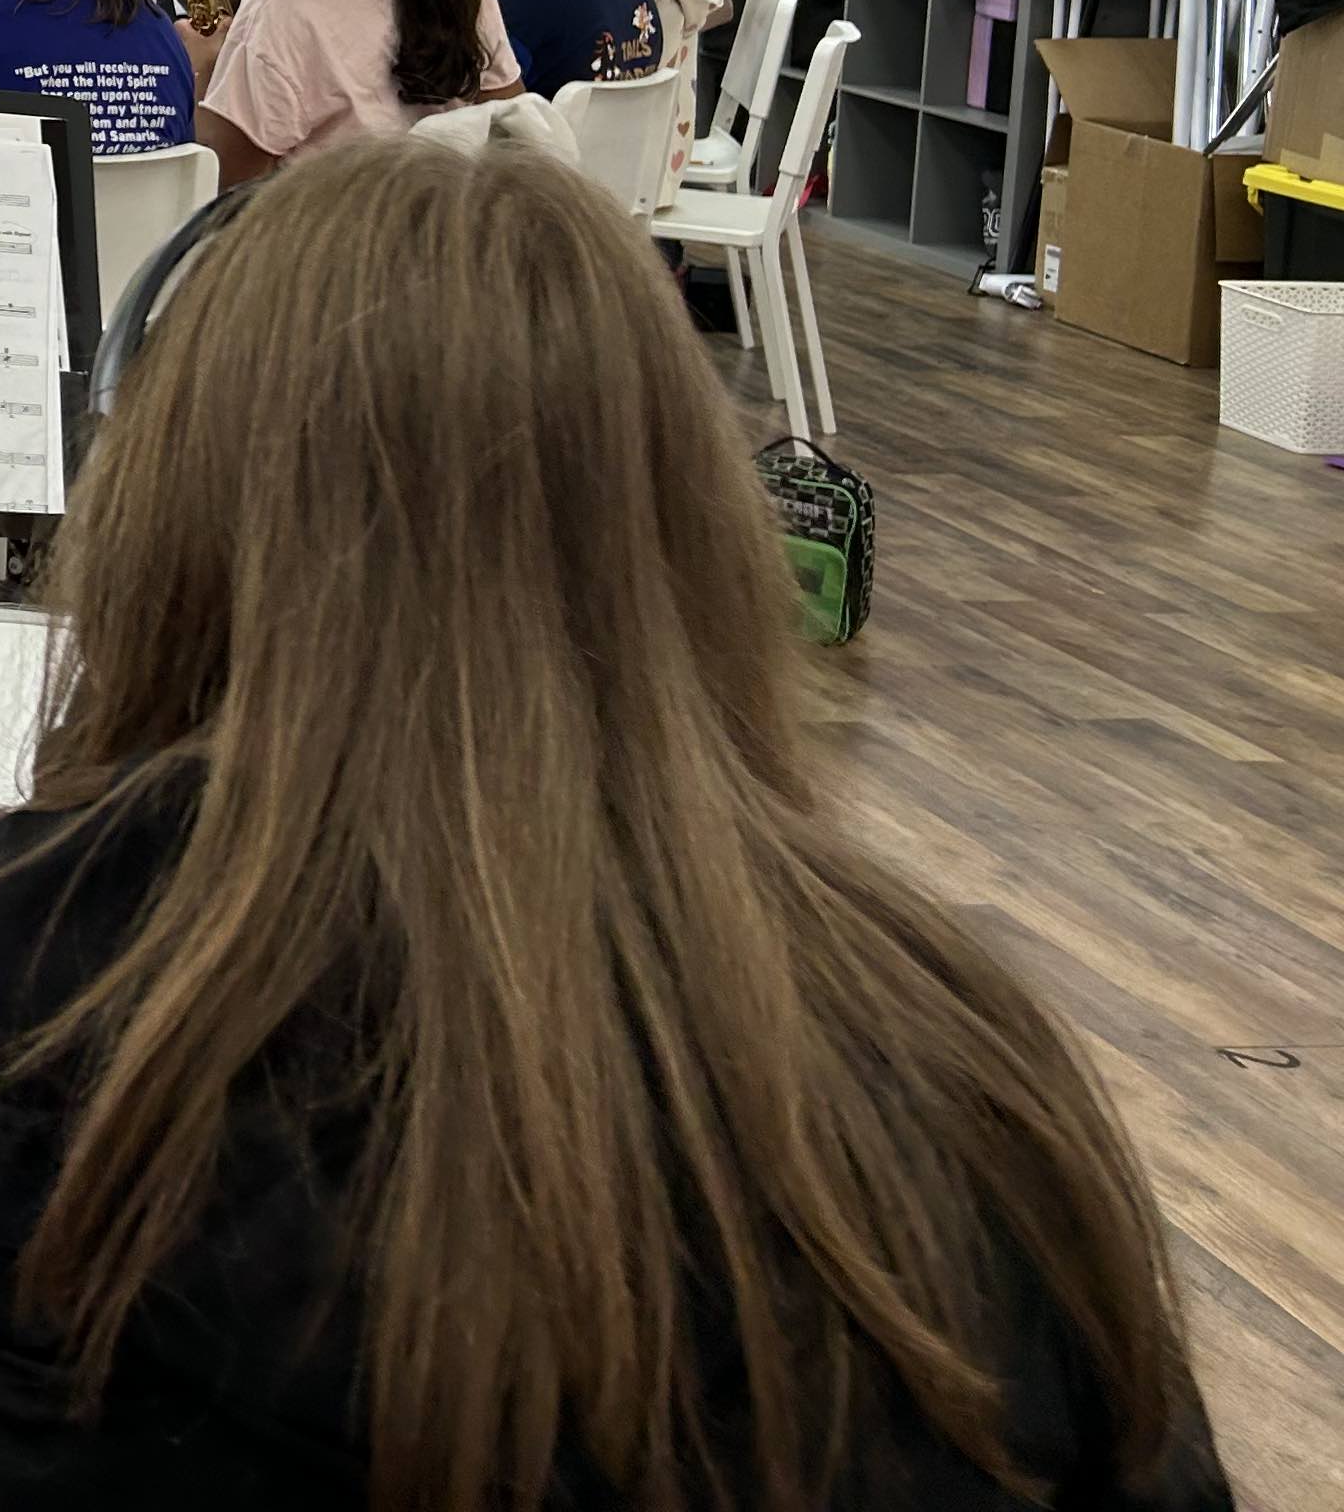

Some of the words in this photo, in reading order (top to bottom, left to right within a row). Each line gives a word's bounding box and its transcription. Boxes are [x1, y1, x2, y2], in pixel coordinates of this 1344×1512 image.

[52, 64, 72, 77] you
[75, 62, 96, 74] will
[99, 62, 139, 74] receive
[142, 64, 169, 76] power
[40, 76, 69, 88] when
[73, 75, 93, 87] the
[97, 75, 124, 89] Holy
[127, 75, 157, 88] Spirit
[101, 92, 130, 103] upon
[132, 91, 157, 102] you,
[90, 104, 104, 115] be
[107, 106, 126, 117] my
[130, 104, 176, 116] witnesses
[116, 117, 137, 129] and
[91, 130, 106, 142] nd
[92, 144, 104, 154] nd
[106, 144, 121, 155] of
[122, 143, 141, 154] the
